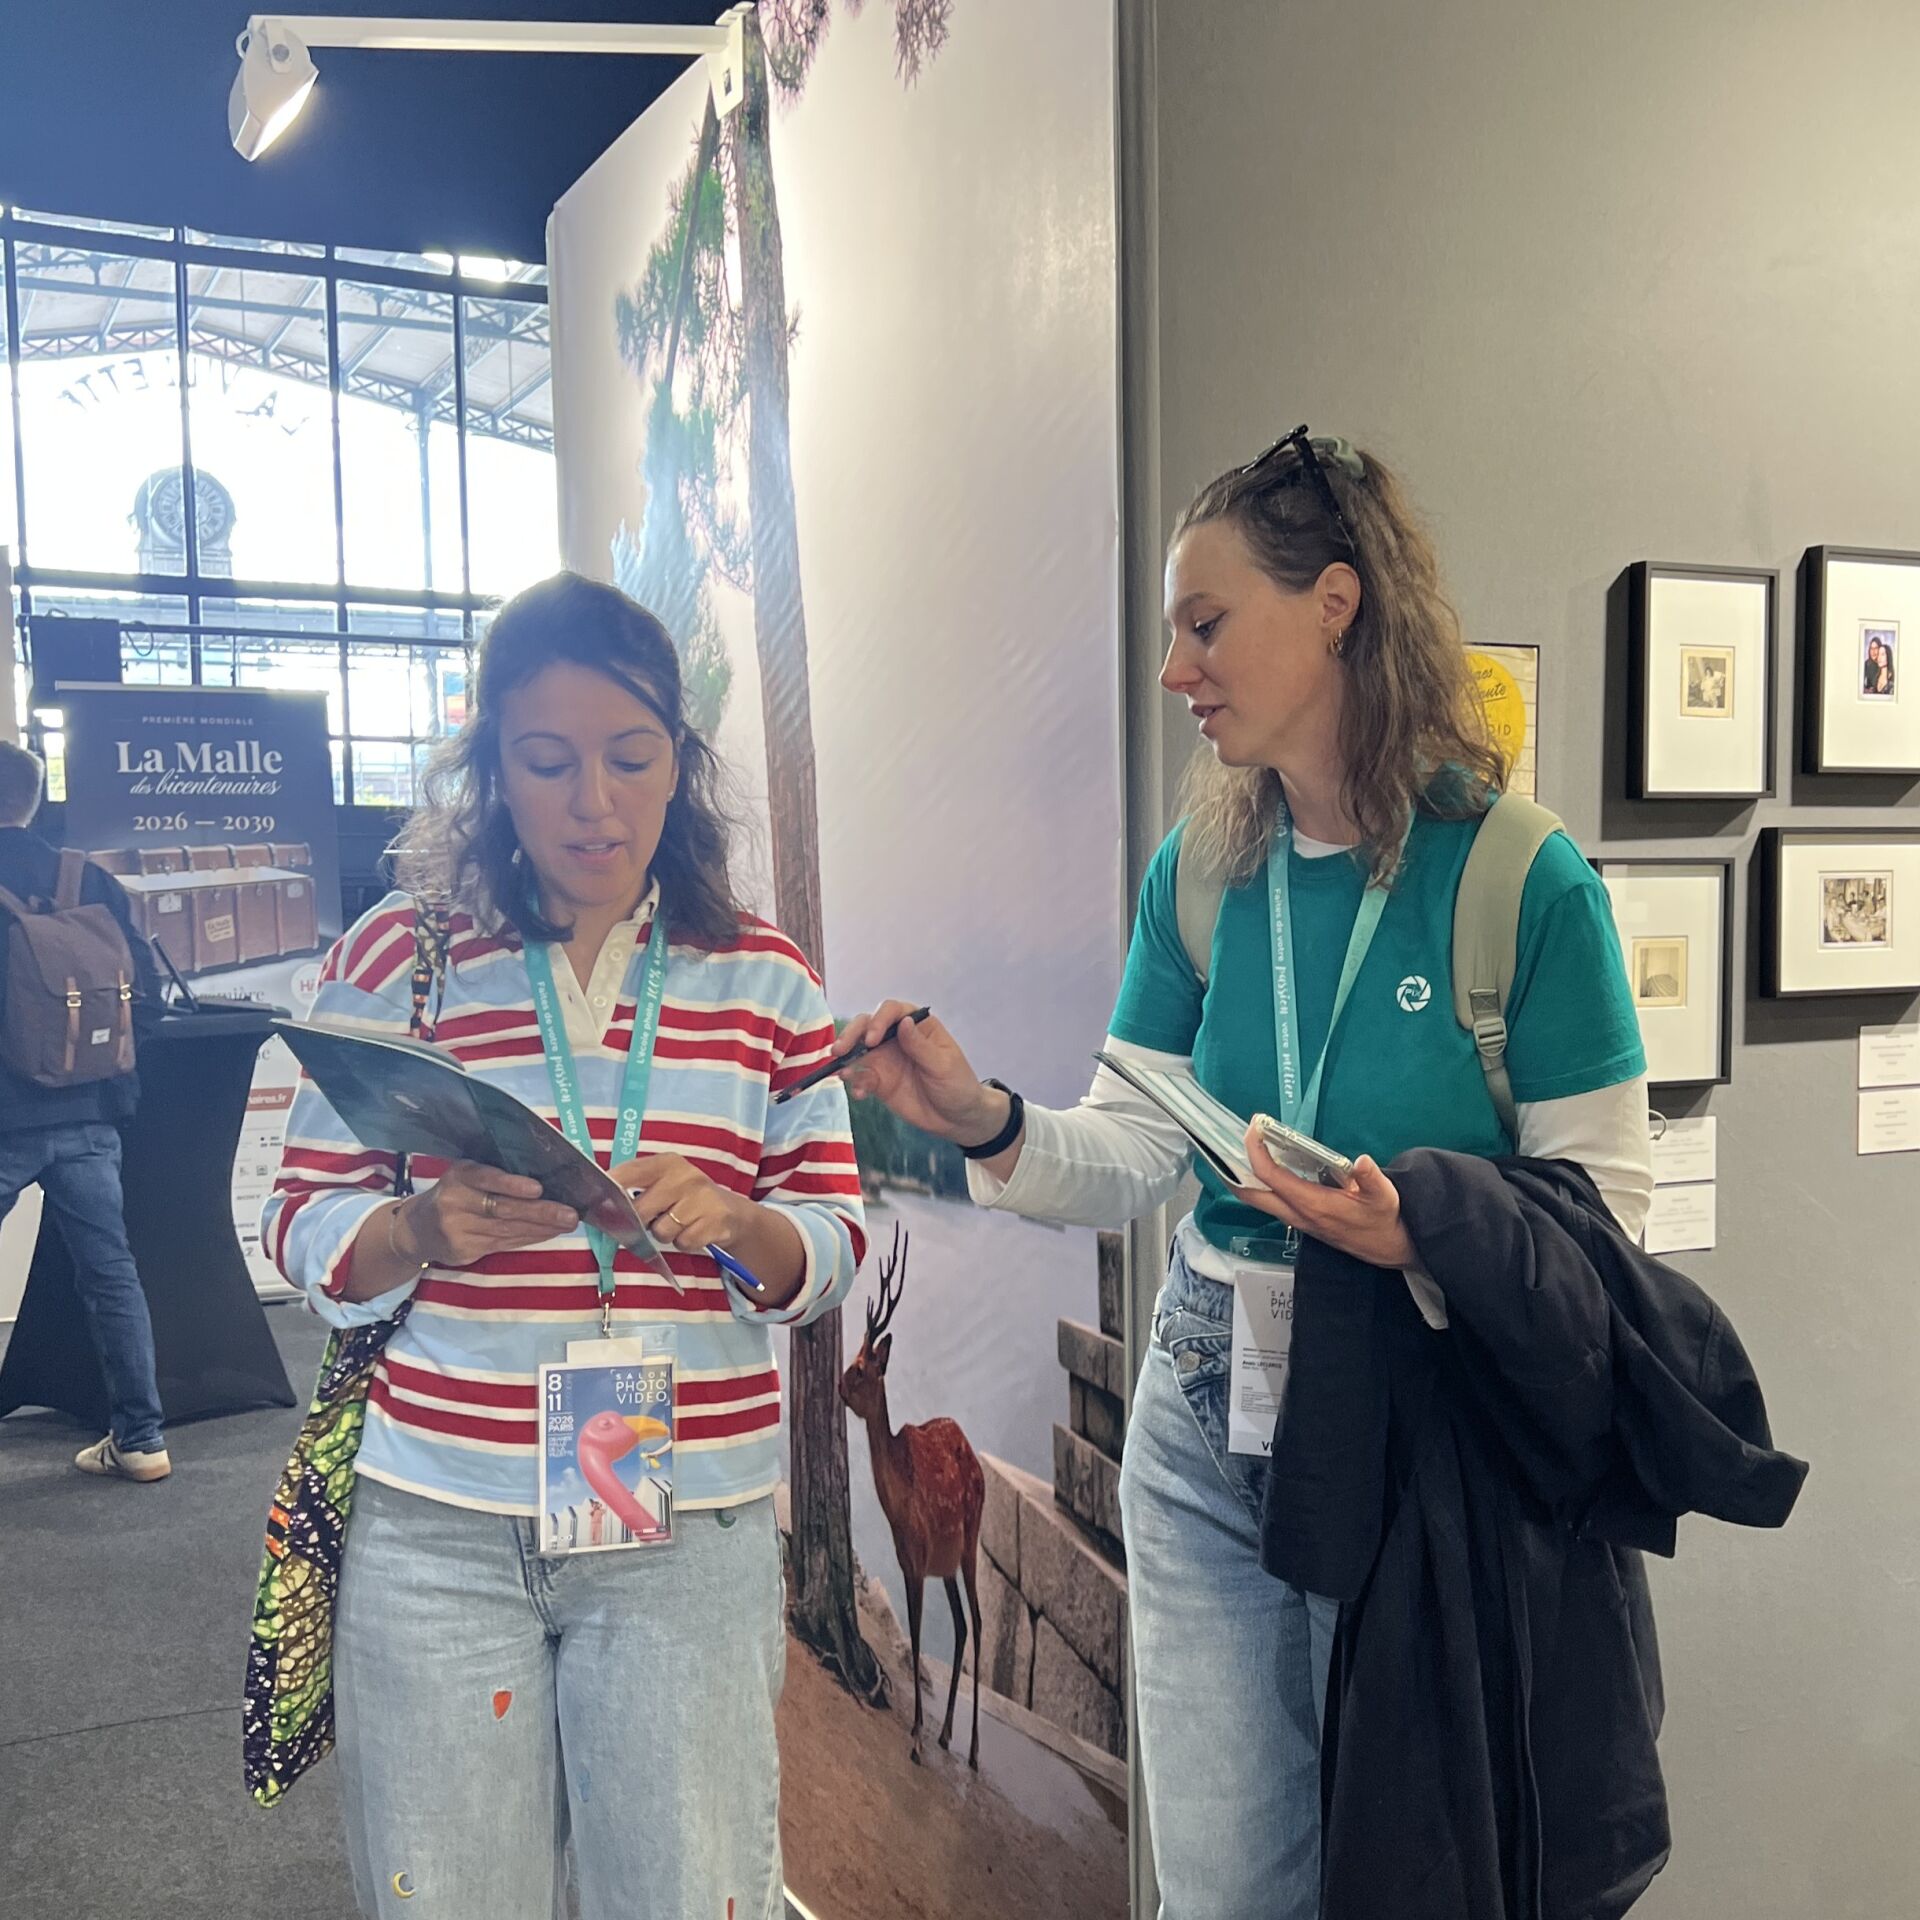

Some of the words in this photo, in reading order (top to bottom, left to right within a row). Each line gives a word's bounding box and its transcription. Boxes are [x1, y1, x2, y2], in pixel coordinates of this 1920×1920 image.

[142, 715, 196, 725] PREMIÈRE
[200, 716, 254, 726] MONDIALE
[115, 741, 166, 773] La
[174, 740, 283, 774] Malle
[130, 776, 153, 795] des
[155, 768, 281, 796] bicentenaires
[133, 811, 188, 831] 2026
[222, 815, 275, 834] 2039
[1277, 935, 1285, 962] votre
[646, 967, 662, 999] 100%
[537, 981, 549, 1011] Faites
[544, 1011, 553, 1025] de
[643, 1001, 655, 1030] photo
[548, 1026, 559, 1052] votre
[636, 1031, 649, 1065] L'école
[566, 1109, 578, 1135] votre
[620, 1122, 637, 1156] edaa
[1270, 1297, 1294, 1310] PHO
[1270, 1309, 1294, 1321] VID
[547, 1373, 563, 1392] 8
[615, 1371, 667, 1380] SALON
[615, 1379, 667, 1393] PHOTO
[547, 1393, 562, 1412] 11
[616, 1391, 668, 1405] VIDEO
[548, 1415, 574, 1424] 2026
[548, 1424, 574, 1433] PARIS
